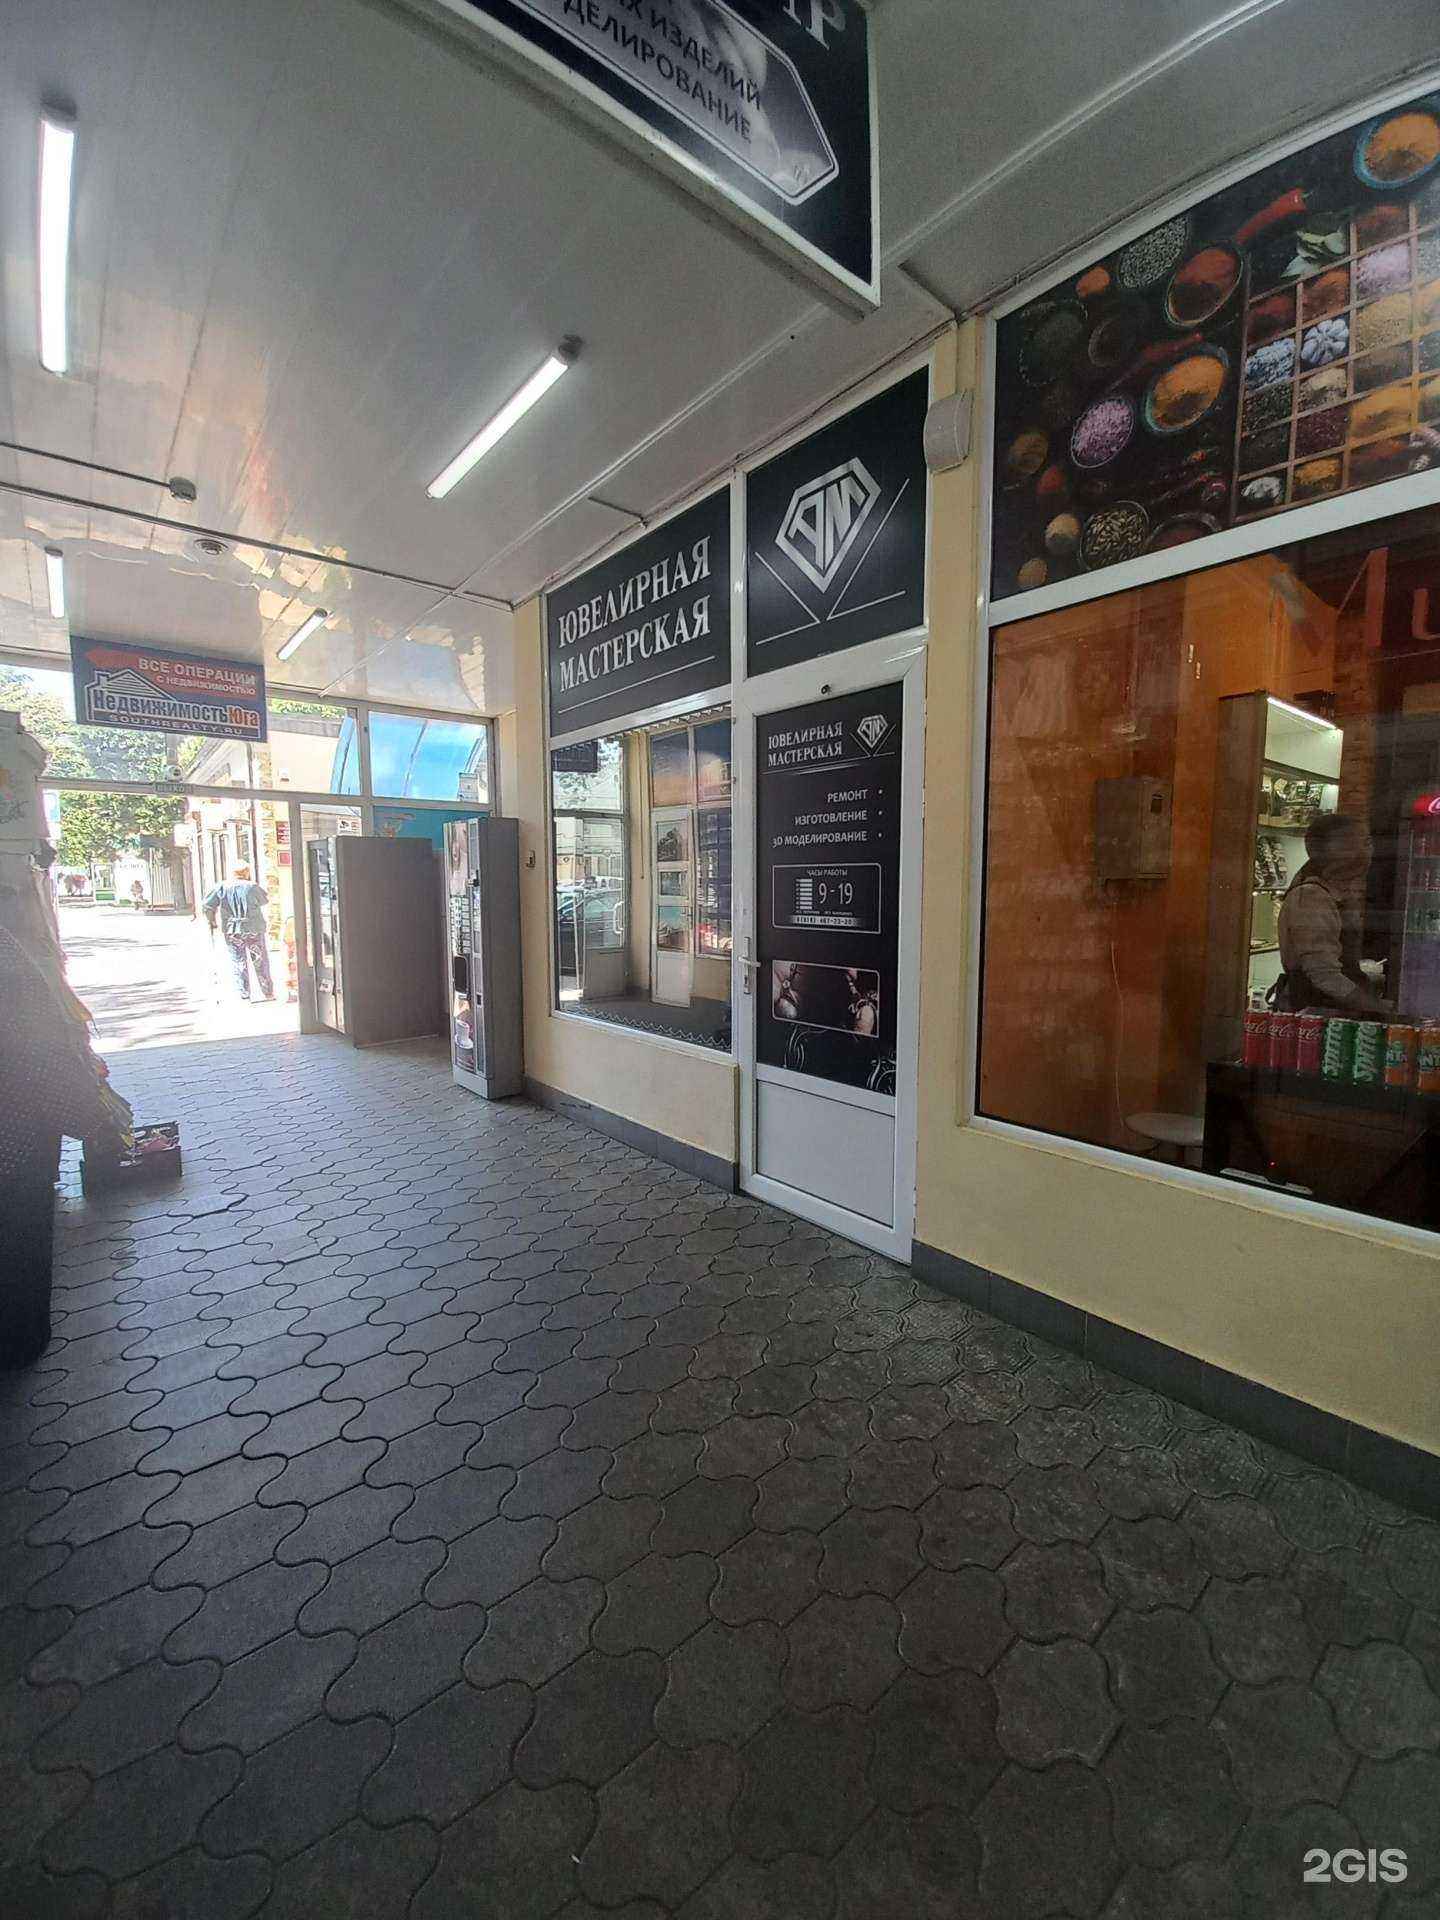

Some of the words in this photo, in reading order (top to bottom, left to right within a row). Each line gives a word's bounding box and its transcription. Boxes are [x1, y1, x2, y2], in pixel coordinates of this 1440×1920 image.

[650, 9, 761, 110] ИЗДЕЛИЙ
[557, 536, 712, 649] ЮВЕЛИРНАЯ
[558, 595, 712, 693] МАСТЕРСКАЯ
[138, 656, 170, 674] ВСЕ
[174, 663, 257, 685] ОПЕРАЦИИ
[166, 676, 257, 696] НЕДВИЖИМОСТЬЮ
[109, 713, 243, 736] SOUTHREALTY.RU
[768, 721, 843, 750] ЮВЕЛИРНАЯ
[768, 741, 843, 768] МАСТЕРСКАЯ
[827, 788, 869, 804] РЕМОНТ
[794, 809, 868, 826] ИЗГОТОВЛЕНИЕ
[784, 830, 868, 846] МОДЕЛИРОВАНИЕ
[806, 868, 823, 878] ЧАСЫ
[823, 868, 848, 877] РАБОТЫ
